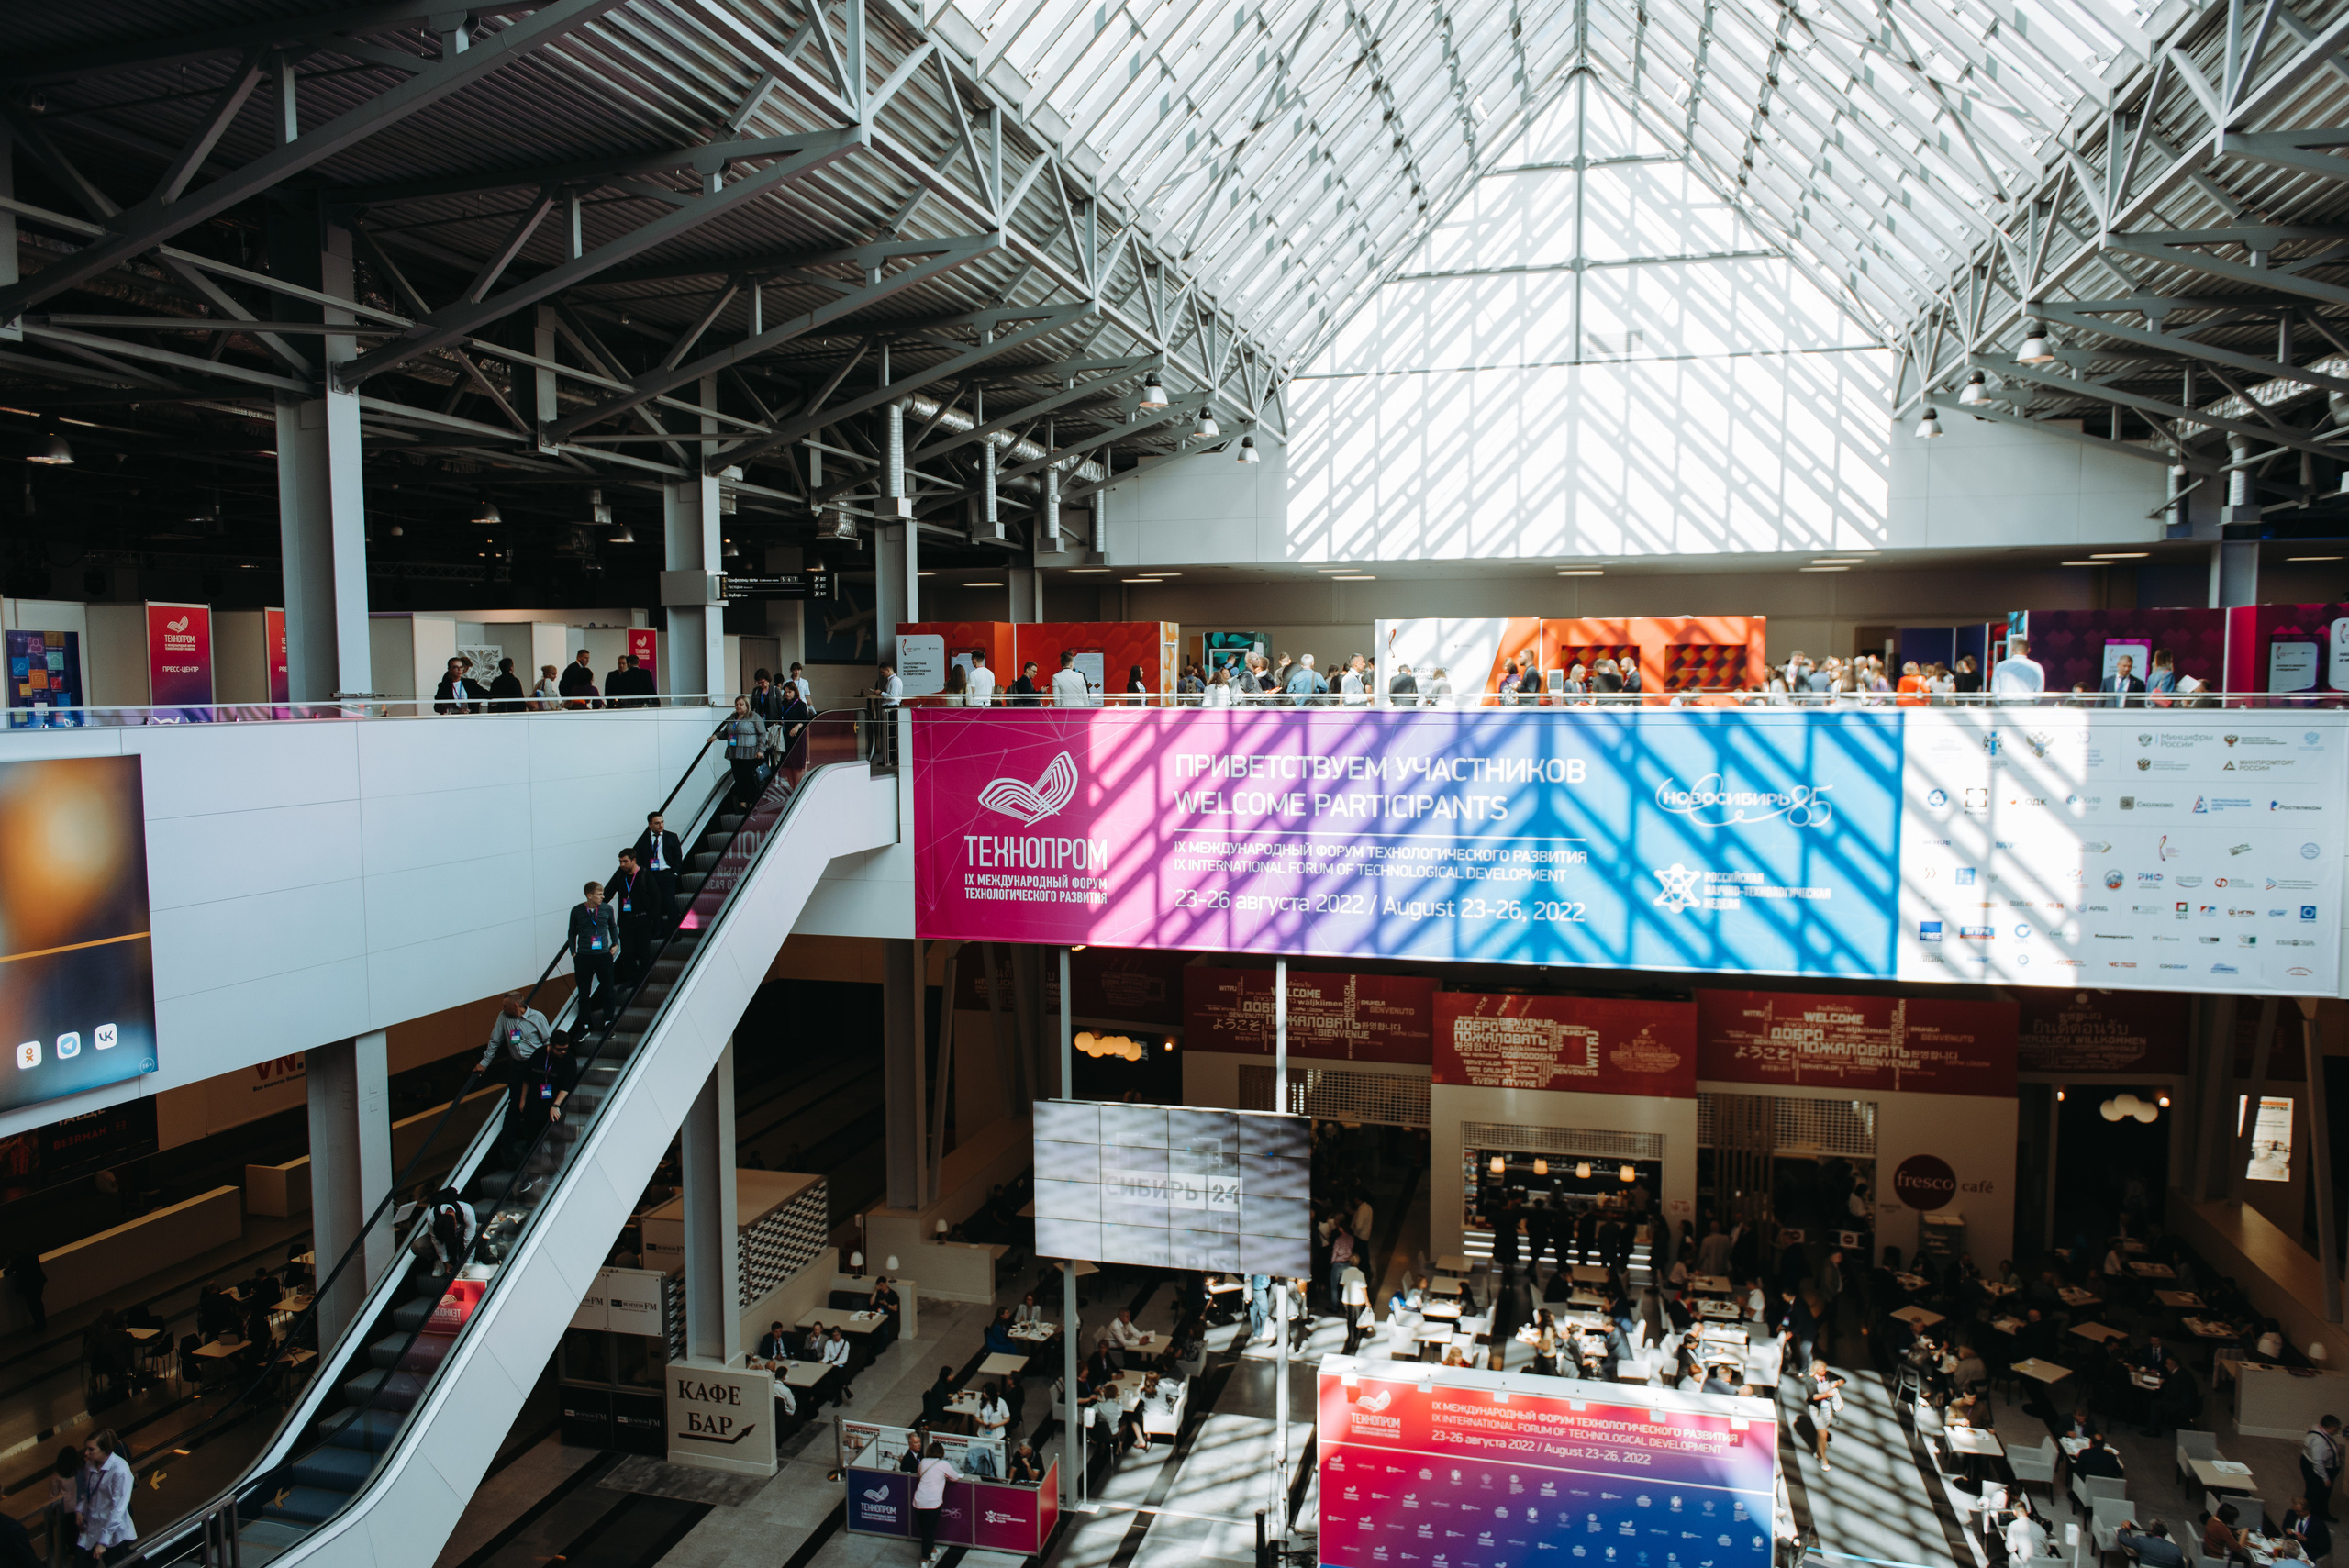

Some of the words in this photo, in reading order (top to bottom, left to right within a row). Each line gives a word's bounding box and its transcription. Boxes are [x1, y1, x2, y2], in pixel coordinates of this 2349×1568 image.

[164, 634, 195, 643] ТЕХНОПРОМ
[2160, 733, 2213, 741] Минцифры
[1175, 754, 1387, 780] ПРИВЕТСТВУЕМ
[1395, 757, 1586, 784] УЧАСТНИКОВ
[1174, 790, 1306, 817] WELCOME
[1314, 793, 1508, 820] PARTICIPANTS
[963, 835, 1108, 870] ТЕХНОПРОМ
[1174, 841, 1186, 853] IX
[1188, 841, 1312, 857] МЕЖДУНАРОДНЫЙ
[1316, 845, 1364, 858] ФОРУМ
[1366, 846, 1510, 862] ТЕХНОЛОГИЧЕСКОГО
[1512, 850, 1587, 864] РАЗВИТИЯ
[1174, 859, 1186, 871] IX
[1188, 859, 1286, 873] INTERNATIONAL
[1288, 862, 1333, 875] FORUM
[1336, 862, 1354, 875] OF
[1356, 863, 1464, 879] TECHNOLOGICAL
[1466, 866, 1567, 882] DEVELOPMENT
[1704, 871, 1764, 884] РОССИЙСКАЯ
[964, 873, 974, 885] IX
[977, 874, 1069, 889] МЕЖДУНАРОДНЫЙ
[1072, 877, 1108, 890] ФОРУМ
[964, 887, 1057, 902] ТЕХНОЛОГИЧЕСКОГО
[1059, 891, 1108, 904] РАЗВИТИЯ
[1703, 884, 1831, 900] НАУЧНО-ТЕХНОЛОГИЧЕСКАЯ
[1174, 888, 1230, 909] 23-26
[1235, 895, 1310, 916] августа
[1316, 894, 1364, 914] 2022
[1369, 895, 1378, 915] /
[1383, 895, 1455, 921] August
[1460, 898, 1528, 923] 23-26,
[1533, 900, 1586, 922] 2022
[1703, 898, 1740, 911] НЕДЕЛЯ
[1271, 986, 1321, 999] WLCOME
[1243, 1001, 1288, 1013] ДОБР
[1213, 1018, 1260, 1032] ようこそ
[1266, 1013, 1361, 1029] ПЖАЛОВАТЬ
[1454, 1019, 1499, 1032] ДОБРО
[1499, 1017, 1553, 1028] BIENVENUE
[1803, 1012, 1864, 1025] WELCOME
[1318, 1028, 1370, 1039] BIENVENUE
[1454, 1031, 1548, 1046] ПОЖАЛОВАТЬ
[1770, 1027, 1824, 1041] ДОБРО
[1586, 1030, 1599, 1068] WITAJ
[1735, 1045, 1791, 1061] ようこそ
[1798, 1040, 1910, 1058] ПОЖАЛОВАТЬ
[1859, 1057, 1920, 1069] BIENVENUE
[1472, 1077, 1500, 1085] SVEIKI
[1105, 1175, 1199, 1202] СИБИРЬ
[1897, 1170, 1954, 1191] fresco
[1961, 1180, 1994, 1193] café
[678, 1379, 741, 1406] КАФЕ
[687, 1411, 733, 1435] БАР
[1351, 1412, 1401, 1429] ТЕХНОПРОМ
[1432, 1401, 1442, 1410] IX
[1442, 1403, 1536, 1421] МЕЖДУНАРОДНЫЙ
[1537, 1413, 1574, 1426] ФОРУМ
[1575, 1417, 1682, 1437] ТЕХНОЛОГИЧЕСКОГО
[1683, 1429, 1739, 1444] РАЗВИТИЯ
[1432, 1413, 1442, 1423] IX
[1442, 1415, 1516, 1432] INTERNATIONAL
[1517, 1423, 1552, 1436] FORUM
[1553, 1426, 1566, 1437] OF
[1569, 1428, 1648, 1446] TECHNOLOGICAL
[1649, 1437, 1723, 1455] DEVELOPMENT
[1432, 1429, 1464, 1443] 23-26
[1465, 1436, 1507, 1448] августа
[1508, 1438, 1535, 1452] 2022
[1544, 1443, 1584, 1458] August
[1585, 1447, 1621, 1463] 23-26,
[1623, 1451, 1651, 1466] 2022
[861, 1502, 896, 1515] ТЕХНОПРОМ
